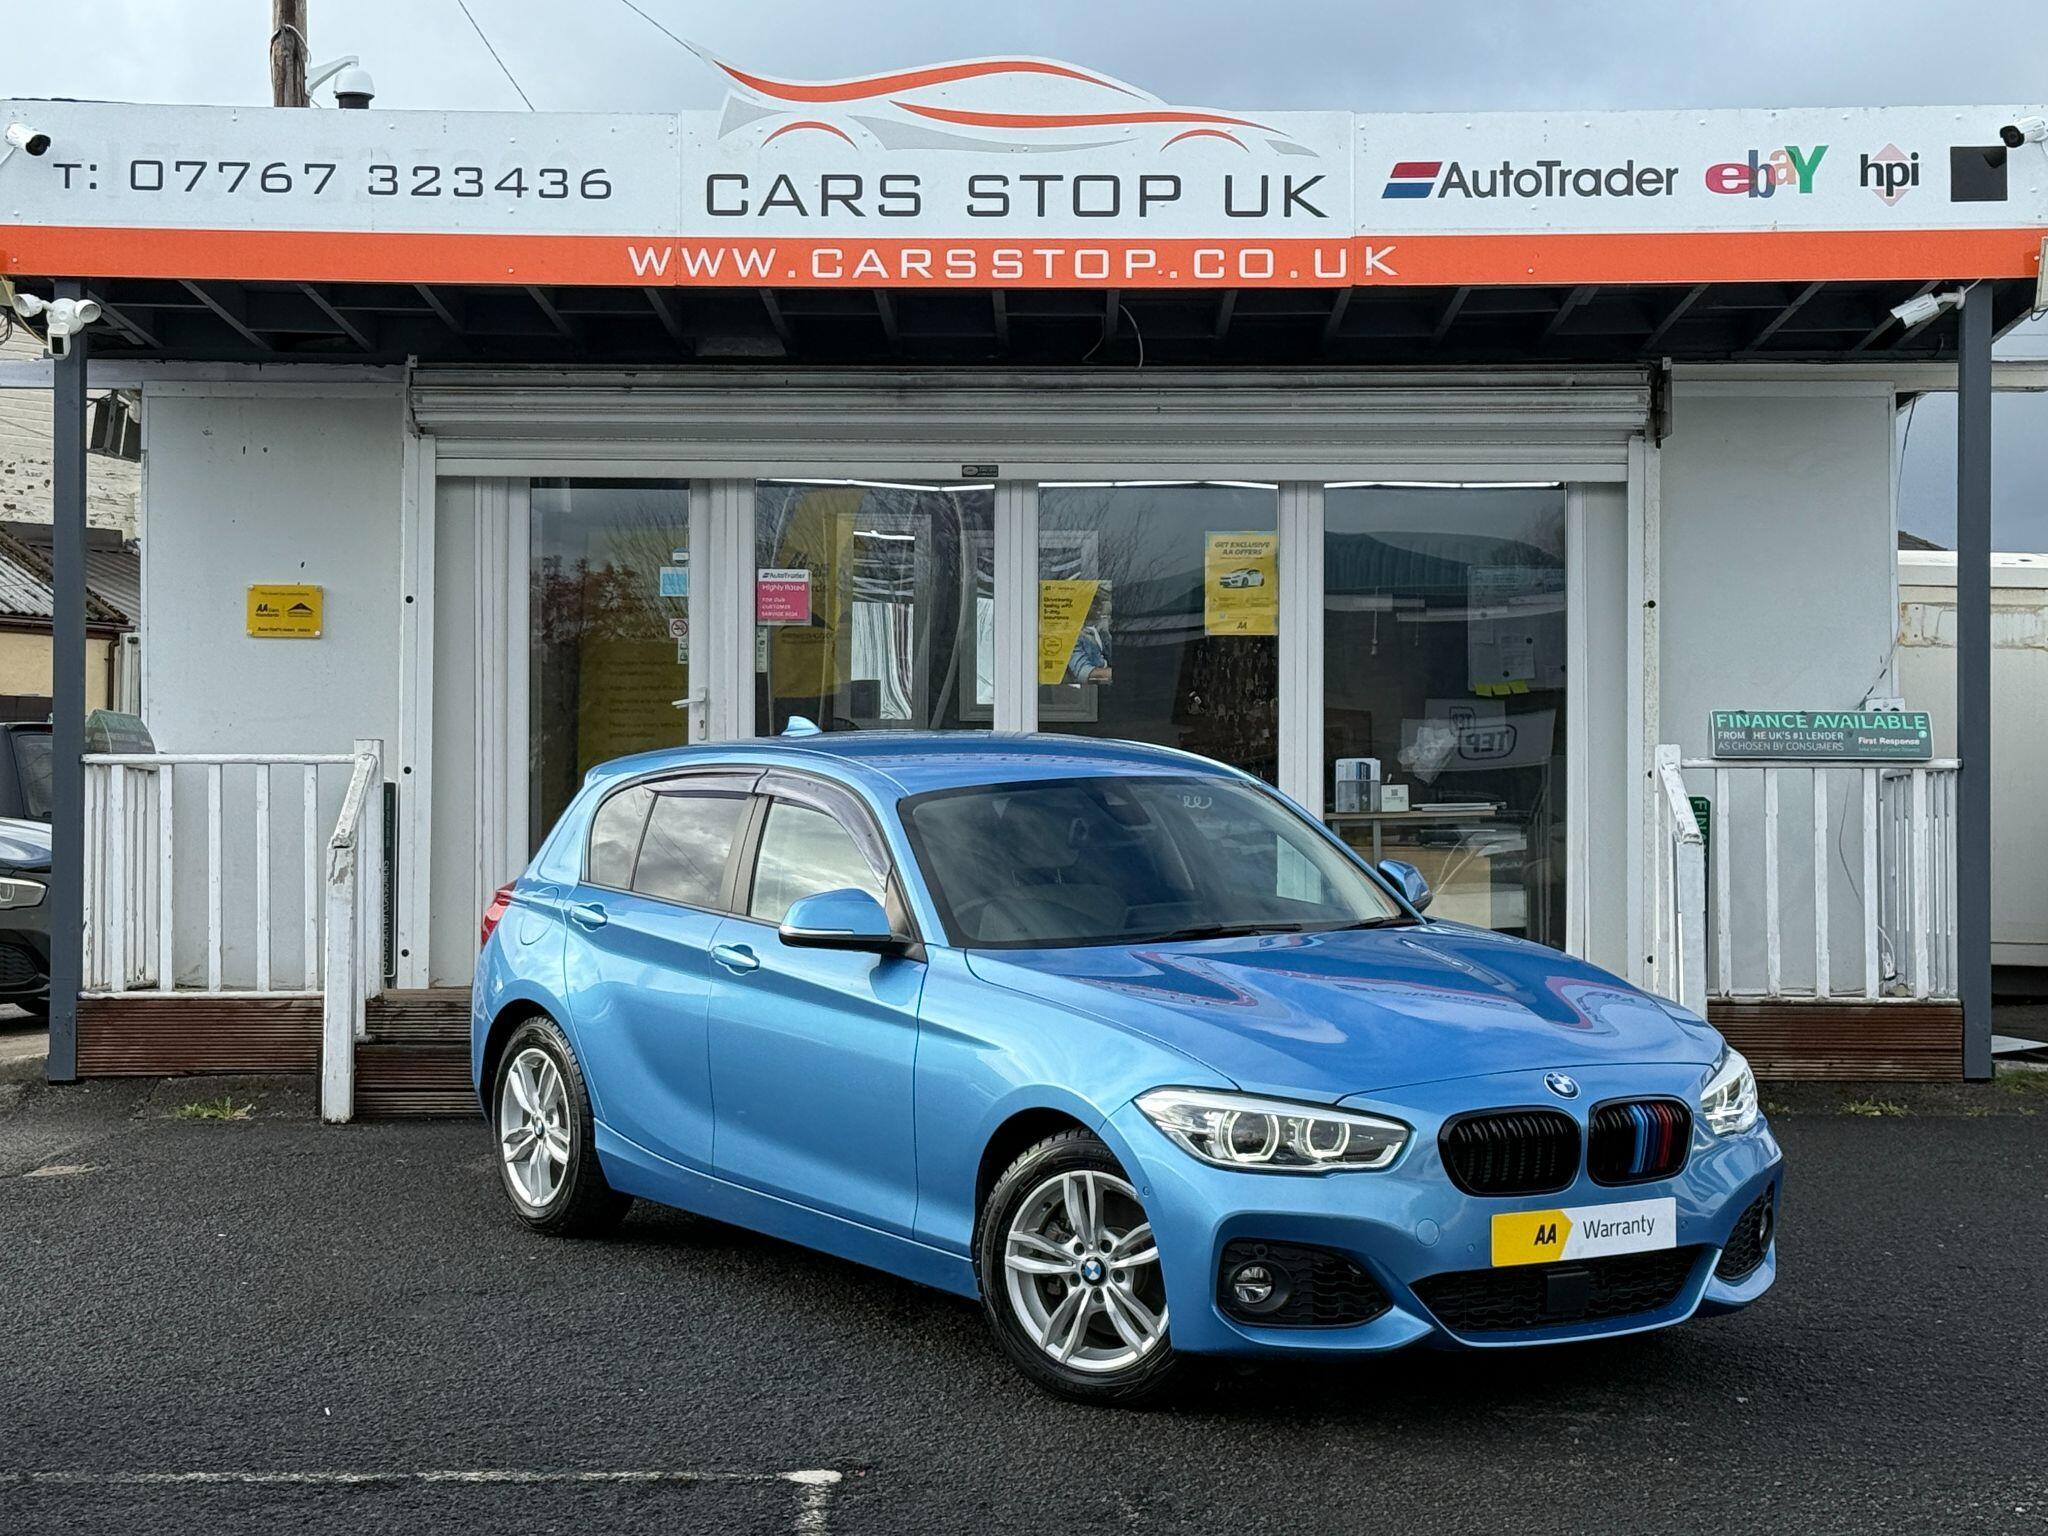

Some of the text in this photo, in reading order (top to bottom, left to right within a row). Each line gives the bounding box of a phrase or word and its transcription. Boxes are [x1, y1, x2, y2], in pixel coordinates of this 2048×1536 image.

[53, 159, 612, 200] T: 07767 323436
[1438, 158, 1678, 198] AutoTrader
[1860, 151, 1920, 198] hpi
[706, 174, 1329, 218] CARS STOP UK
[628, 245, 1398, 281] WWW.CARSSTOP.CO.UK
[1716, 714, 1927, 730] FINANCE AVAILABLE
[1718, 731, 1746, 740] FROM
[1768, 731, 1791, 740] UK'S
[1806, 731, 1844, 740] LENDER
[1718, 742, 1844, 752] AS CHOSEN BY CONSUMERS
[1858, 736, 1920, 746] First Response
[1533, 1214, 1656, 1246] AA Warranty
